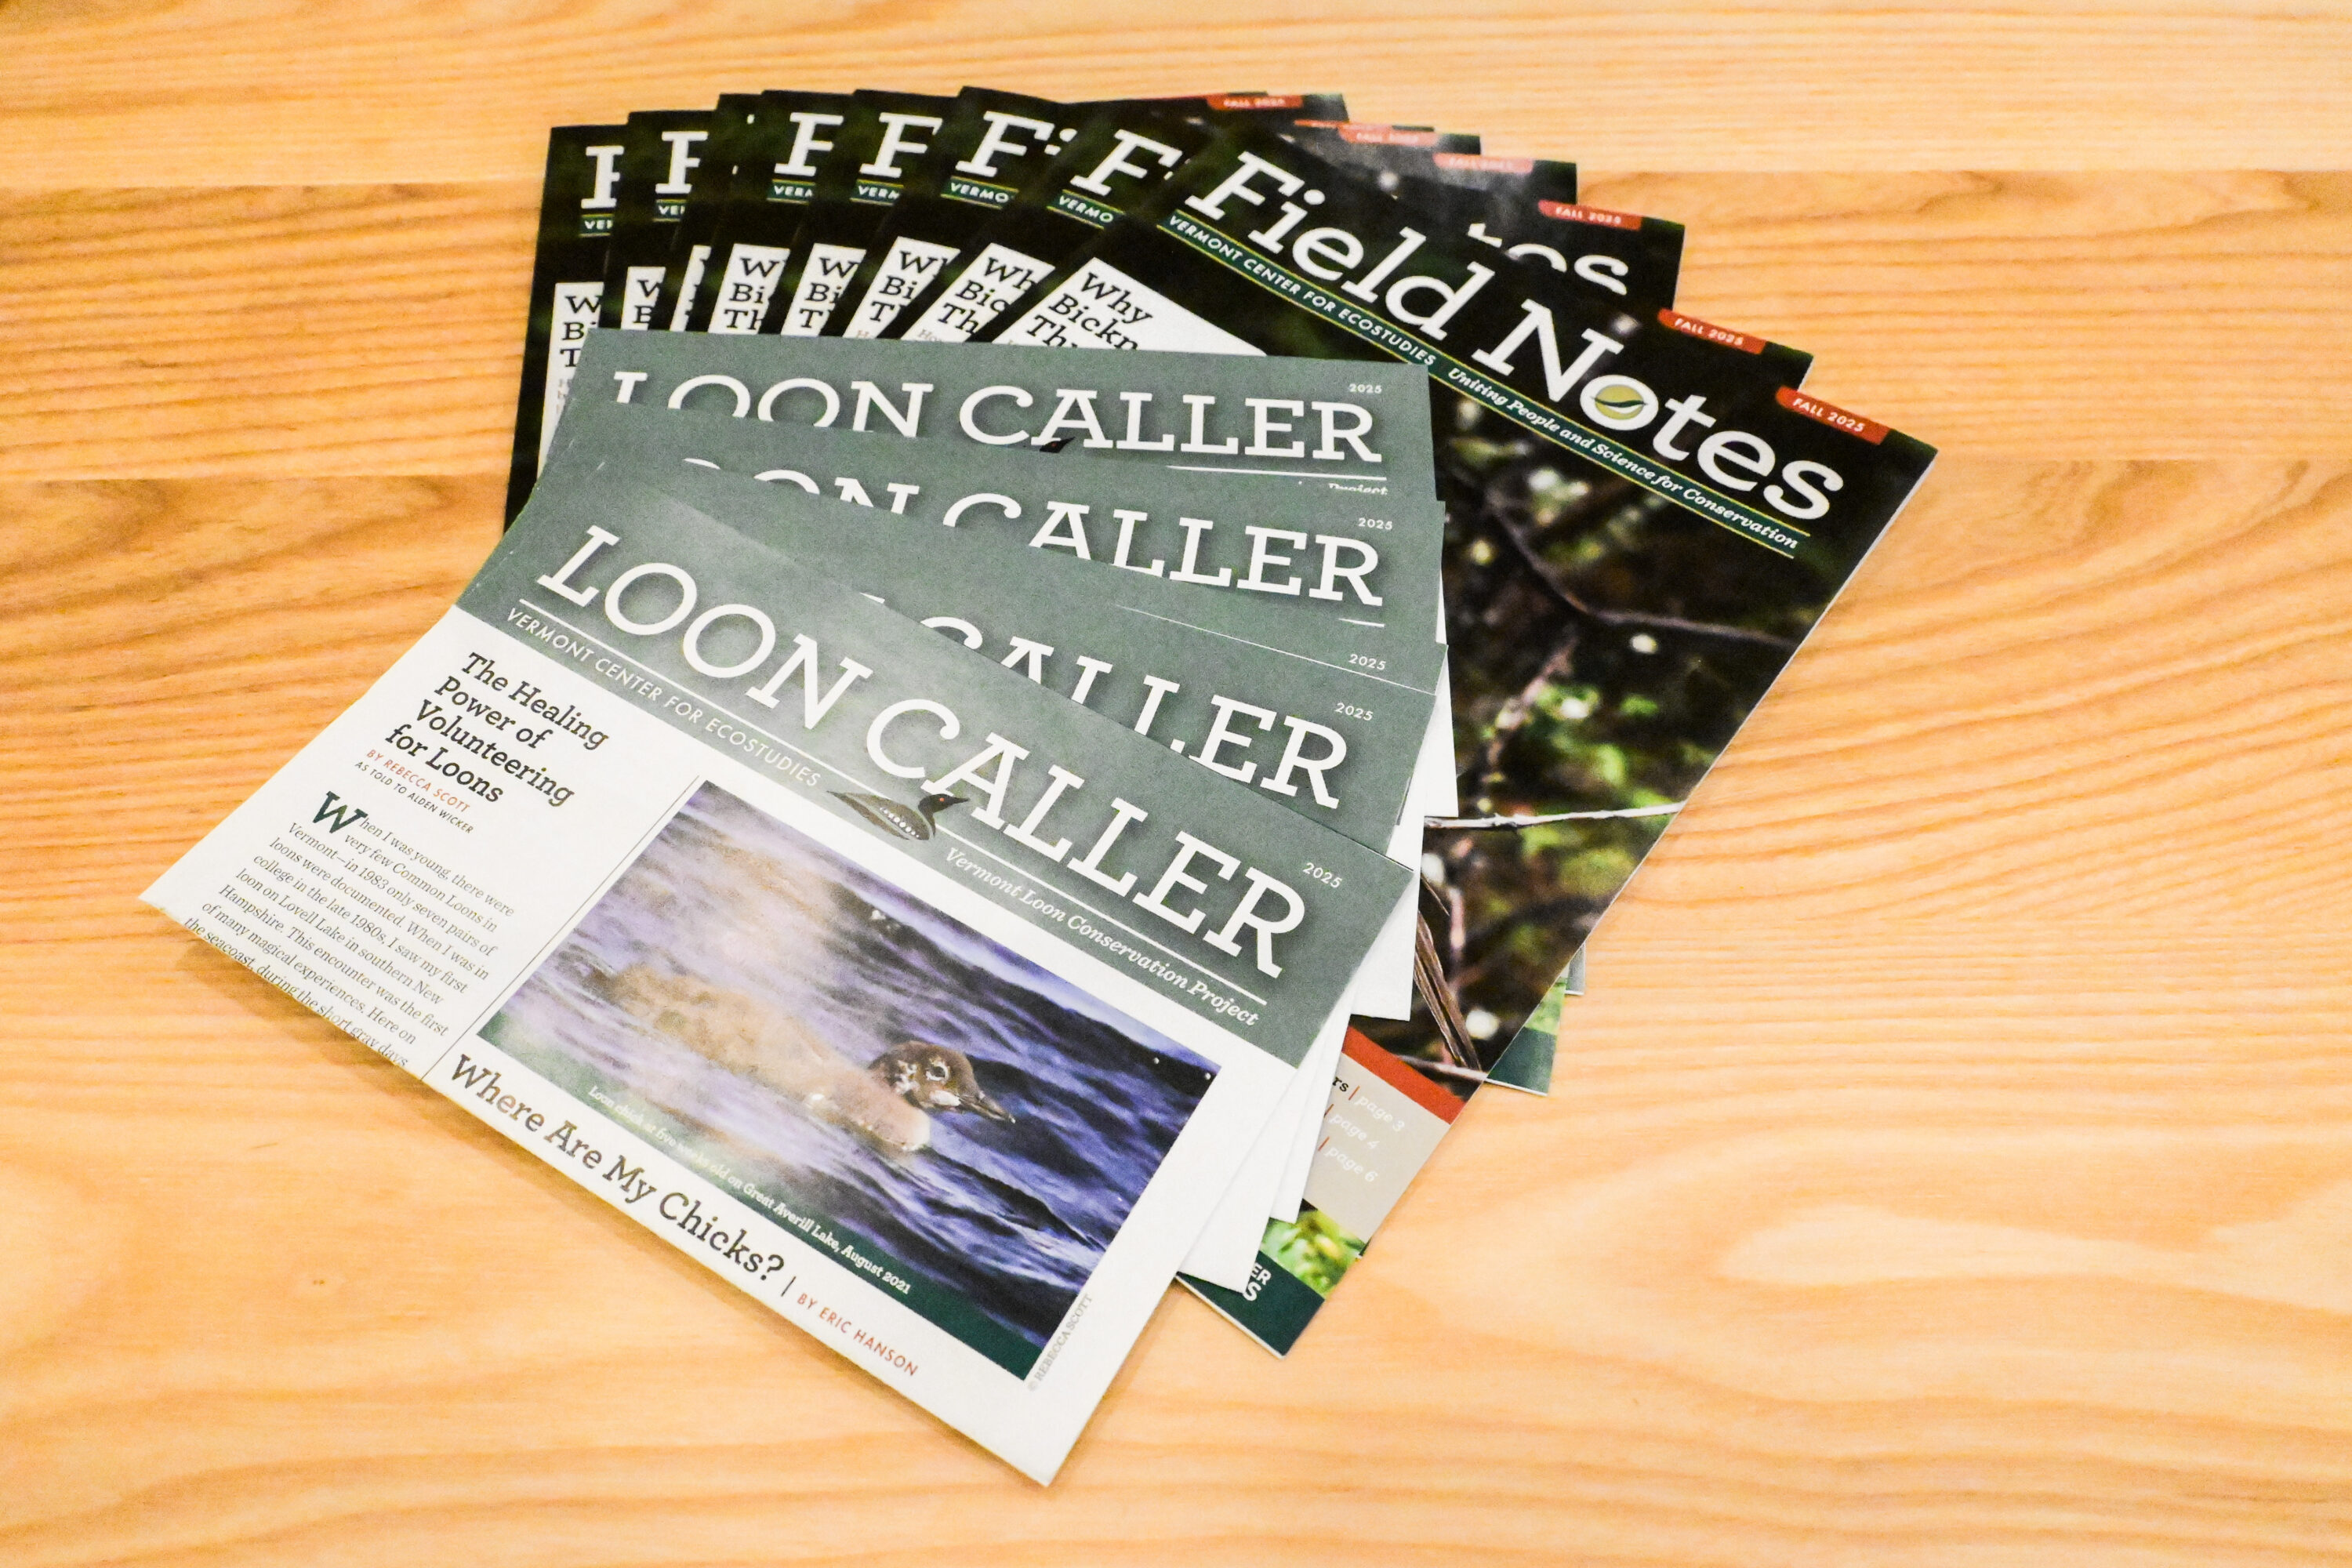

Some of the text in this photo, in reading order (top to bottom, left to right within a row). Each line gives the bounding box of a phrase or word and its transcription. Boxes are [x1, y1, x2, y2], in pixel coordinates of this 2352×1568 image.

[1081, 272, 1153, 324] Why
[1169, 216, 1437, 366] VERMONT CENTER FOR ECOSTUDIES
[1185, 151, 1844, 519] Field Notes
[1675, 318, 1744, 347] FALL 2025
[959, 385, 1382, 463] CALLER
[1348, 383, 1383, 394] 2025
[1792, 397, 1865, 433] FALL 2025
[1447, 368, 1800, 550] Uniting People and Science for Conservation
[1358, 517, 1393, 531] 2025
[461, 652, 609, 750] The Healing
[506, 607, 822, 786] VERMONT CENTER FOR ECOSTUDIES
[1348, 653, 1387, 670] 2025
[416, 699, 575, 807] Volunteering
[434, 676, 554, 749] Power of
[536, 524, 1305, 979] LOON CALLER
[1335, 702, 1374, 720] 2025
[354, 761, 474, 834] AS TOLD TO ALDEN WICKER
[366, 750, 470, 812] BY REBECCA SCOTT
[385, 725, 503, 802] for Loons
[269, 837, 489, 981] loons were documented. When I was in
[344, 834, 498, 933] very few Common Loons in
[358, 867, 389, 890] 1983
[387, 887, 415, 907] only
[412, 902, 448, 928] seven
[445, 924, 480, 948] pairs
[479, 944, 499, 956] of
[382, 832, 392, 841] I
[390, 837, 414, 855] was
[410, 852, 452, 880] young,
[452, 874, 484, 898] there
[485, 895, 514, 917] were
[1301, 862, 1342, 889] 2025
[218, 884, 449, 1036] Hampshire. This encounter was the first
[235, 868, 445, 1005] loon on Lovell Lake in southern New
[253, 855, 469, 994] college in the late 1980s, I saw my first
[945, 847, 1260, 1026] Vermont Loon Conservation Project
[183, 917, 205, 935] the
[297, 989, 318, 1008] the
[317, 1005, 352, 1030] short
[201, 902, 417, 1045] of many magical experiences. Here on
[1330, 1112, 1381, 1150] page 4
[1355, 1095, 1406, 1132] page 3
[451, 1054, 785, 1281] Where Are My Chicks?
[588, 1085, 615, 1109] Loon
[615, 1104, 644, 1128] chick
[655, 1127, 677, 1147] five
[710, 1160, 730, 1179] old
[728, 1173, 744, 1189] on
[743, 1183, 775, 1208] Great
[773, 1203, 815, 1233] Averill
[811, 1224, 840, 1253] Lake,
[840, 1244, 884, 1278] August
[882, 1272, 912, 1294] 2021
[1325, 1145, 1379, 1182] page 6
[797, 1292, 919, 1377] BY ERIC HANSON
[1034, 1331, 1070, 1383] REBECCA
[1065, 1293, 1094, 1331] SCOTT
